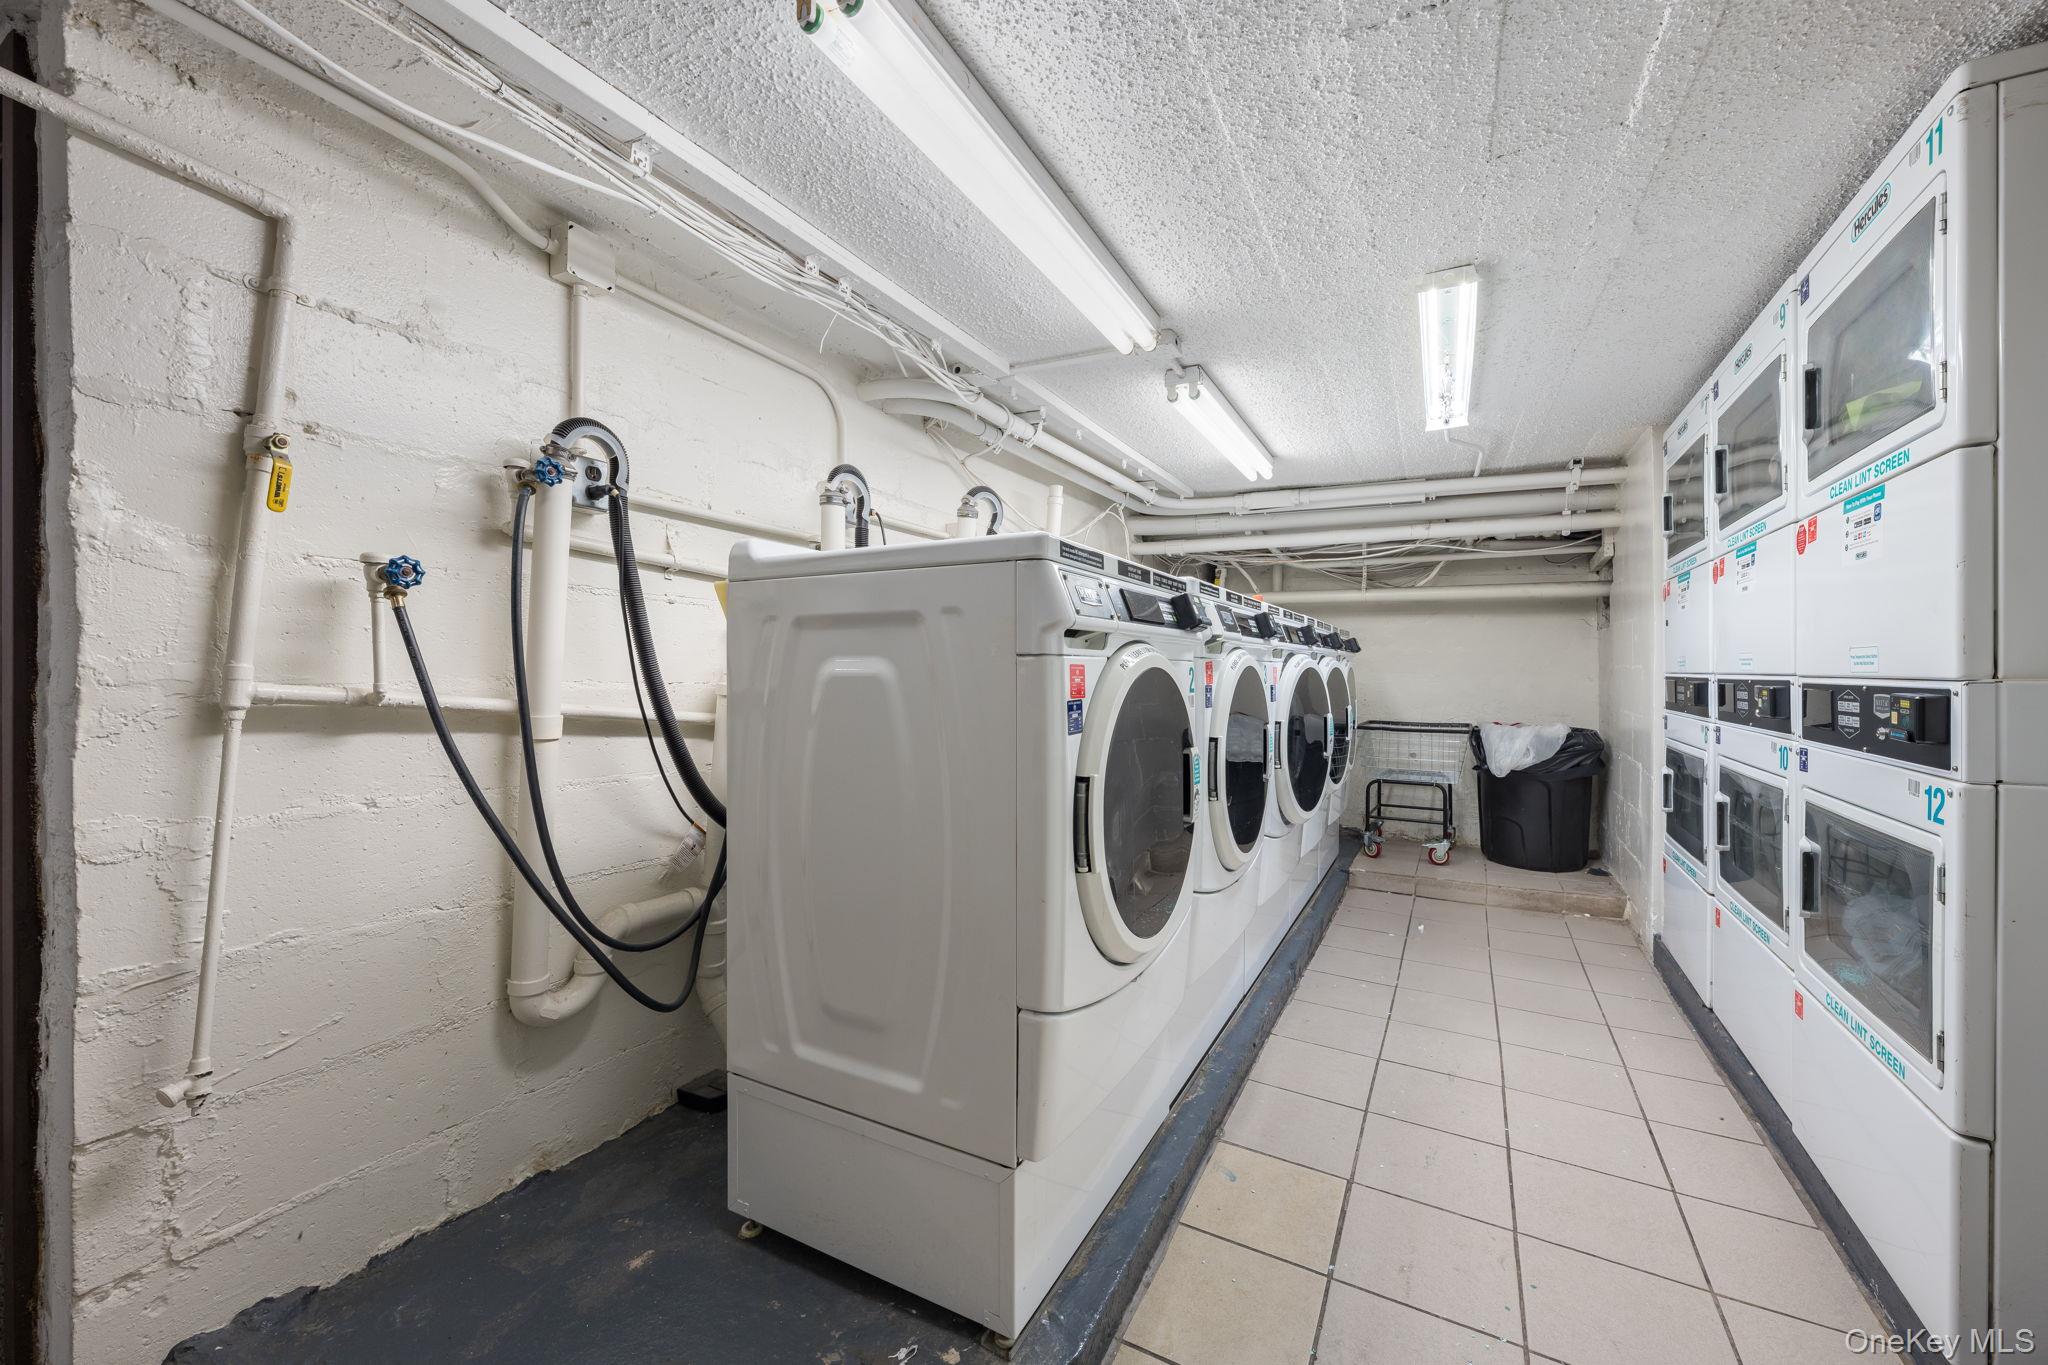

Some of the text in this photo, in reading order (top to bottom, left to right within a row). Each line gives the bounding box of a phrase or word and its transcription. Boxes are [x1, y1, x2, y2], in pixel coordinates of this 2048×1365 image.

[1925, 116, 1944, 166] 11
[1853, 187, 1889, 238] Hercules
[1779, 303, 1786, 329] 9
[1829, 448, 1910, 499] CLEAN LINT SCREEN
[1189, 667, 1195, 693] 2
[1778, 745, 1789, 771] 10
[1924, 784, 1946, 826] 12
[1752, 921, 1770, 945] SCREEN
[1825, 992, 1849, 1024] CLEAN
[1850, 1016, 1868, 1042] LINT
[1869, 1034, 1906, 1080] SCREEN
